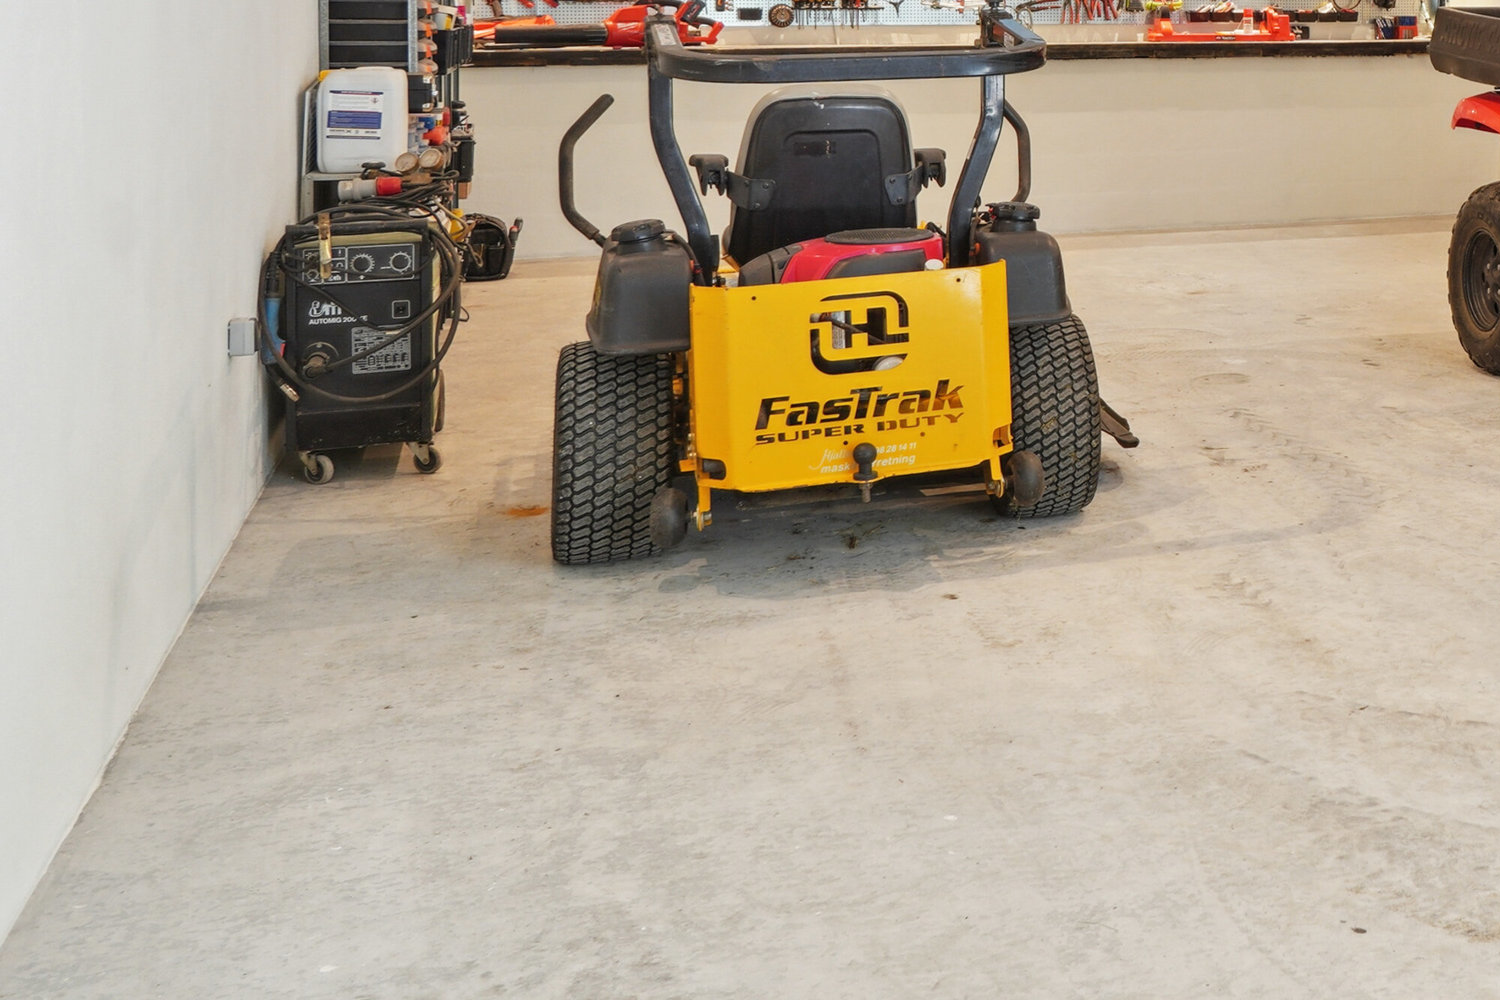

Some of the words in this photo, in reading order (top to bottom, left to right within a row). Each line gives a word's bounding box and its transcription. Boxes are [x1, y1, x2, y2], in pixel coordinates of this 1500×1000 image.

[308, 317, 342, 325] AUTOMIG
[755, 379, 965, 431] FasTrak
[755, 423, 865, 446] SUPER
[876, 412, 965, 432] DUTY
[886, 444, 896, 454] 28
